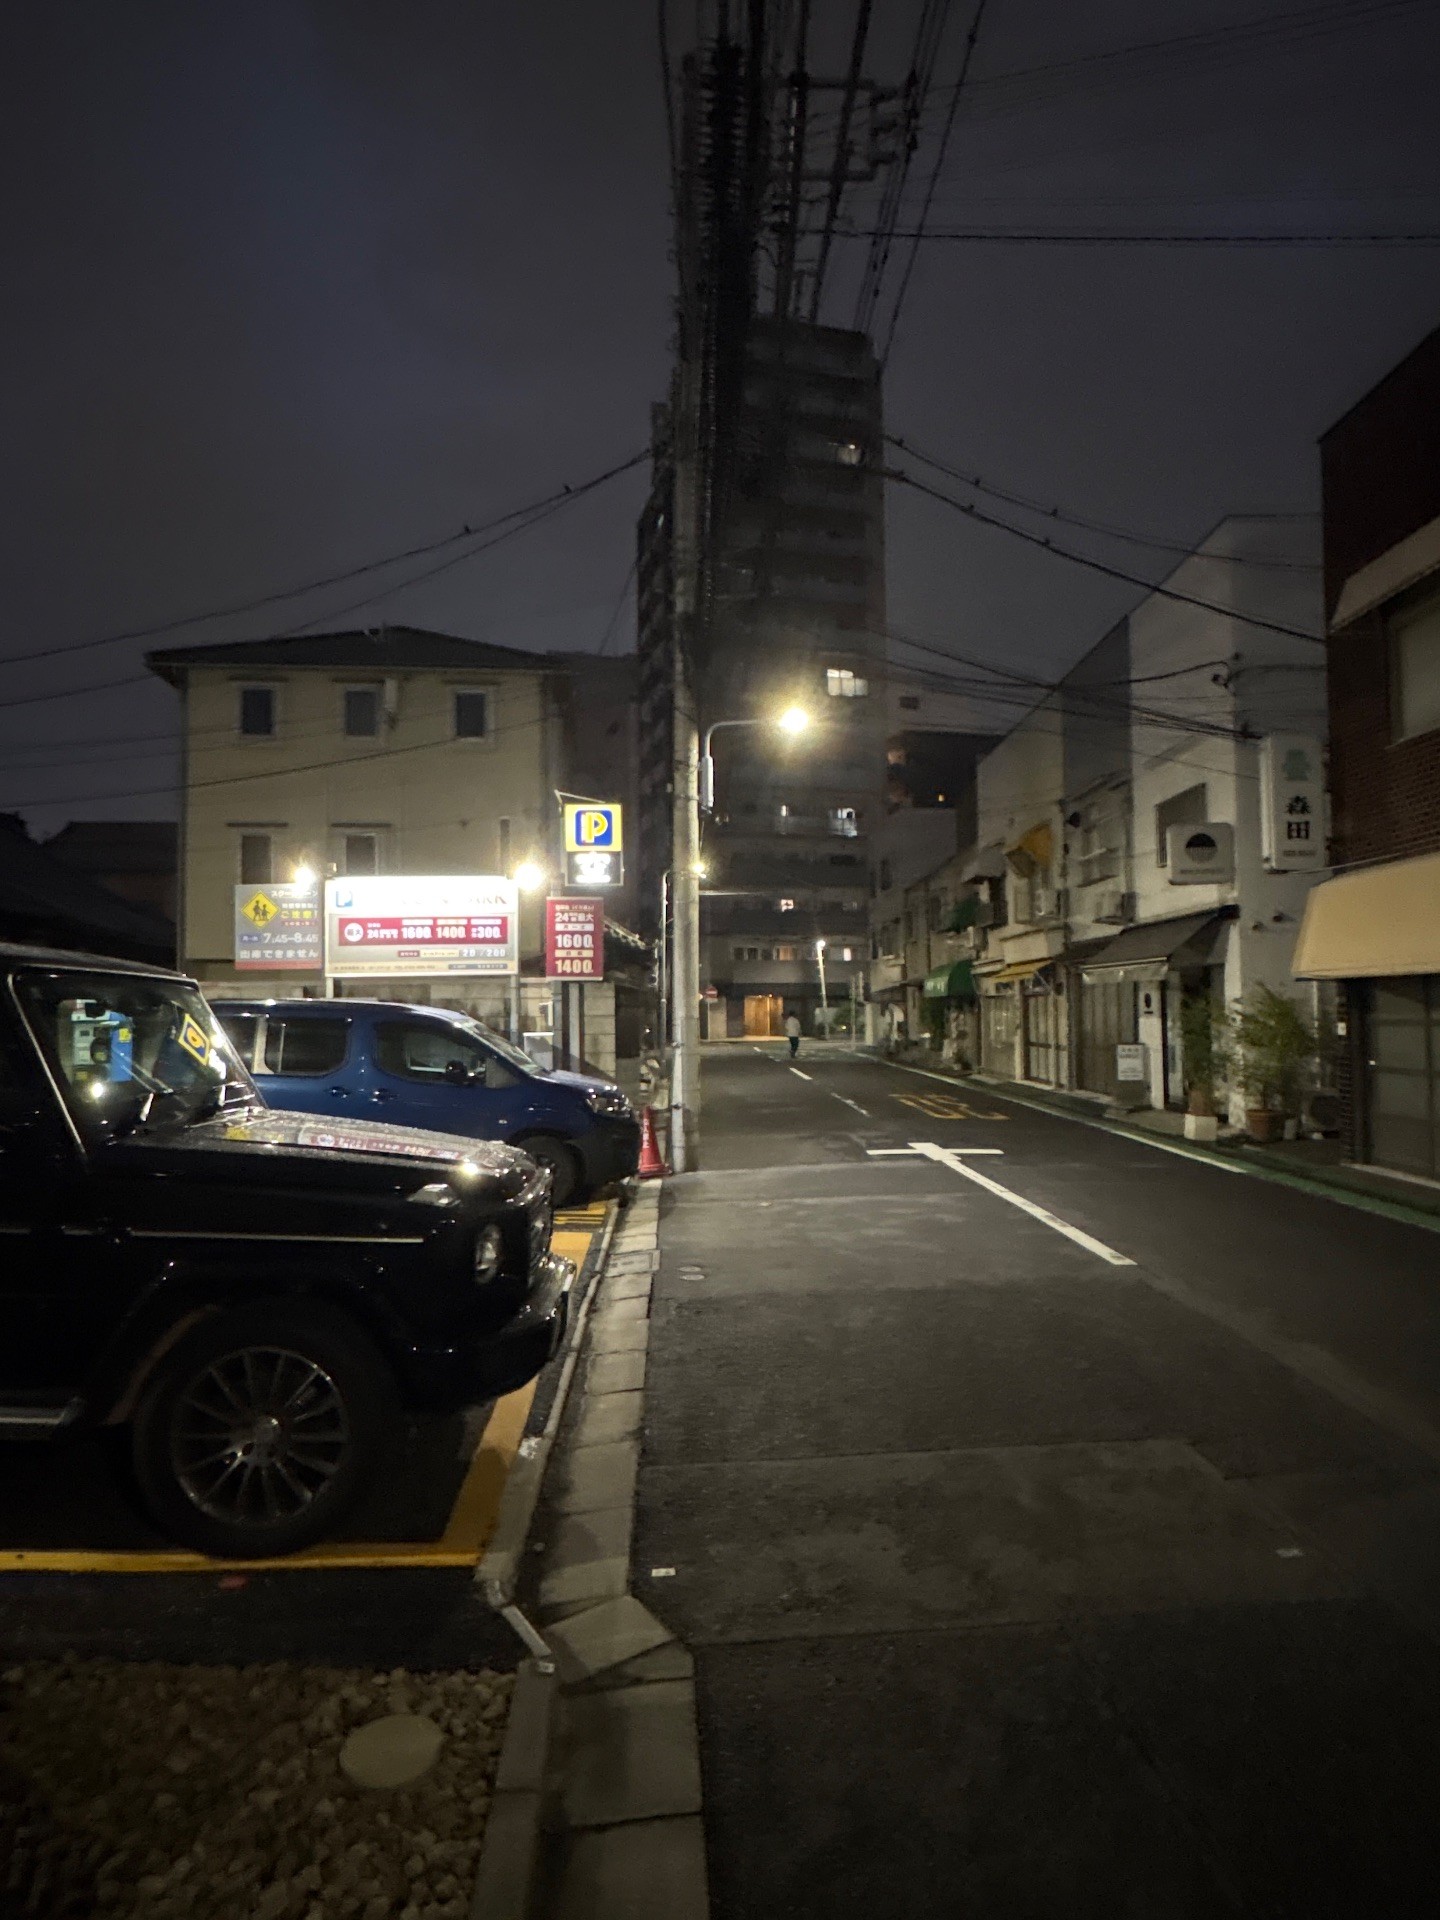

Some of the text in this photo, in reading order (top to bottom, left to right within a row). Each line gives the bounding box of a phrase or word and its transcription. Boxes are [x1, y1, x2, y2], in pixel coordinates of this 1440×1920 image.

[582, 812, 608, 843] P
[1286, 795, 1311, 840] 森田
[271, 890, 318, 898] スクーーン
